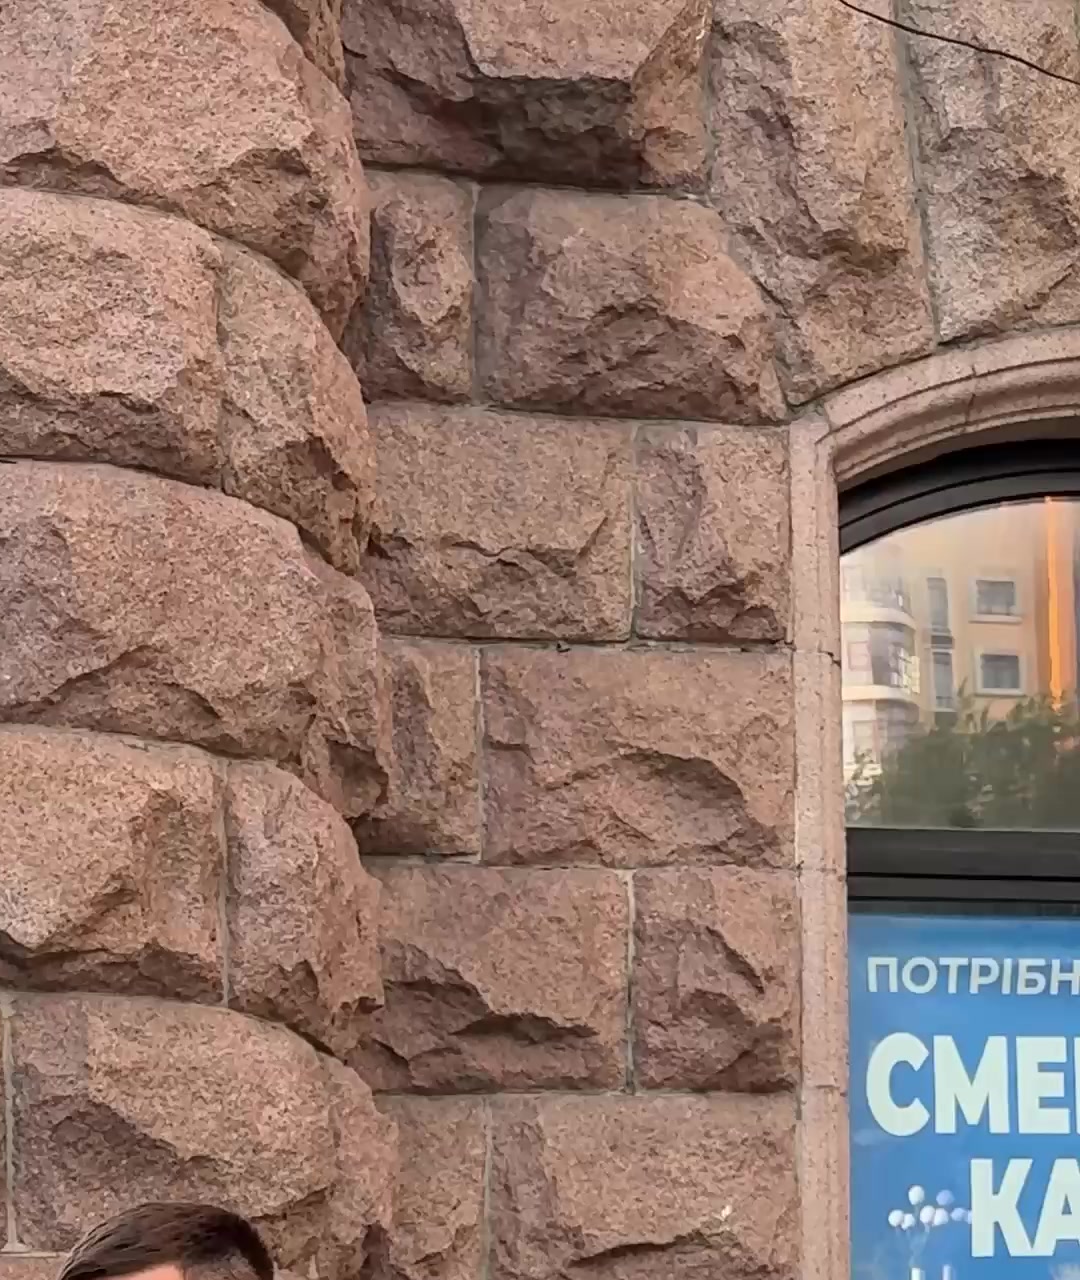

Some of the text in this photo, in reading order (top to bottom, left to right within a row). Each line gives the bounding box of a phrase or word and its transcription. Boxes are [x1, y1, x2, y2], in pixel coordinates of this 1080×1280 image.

[867, 956, 1080, 995] ПОТРІБН
[866, 1032, 1080, 1136] СМЕ
[970, 1158, 1080, 1257] КА
